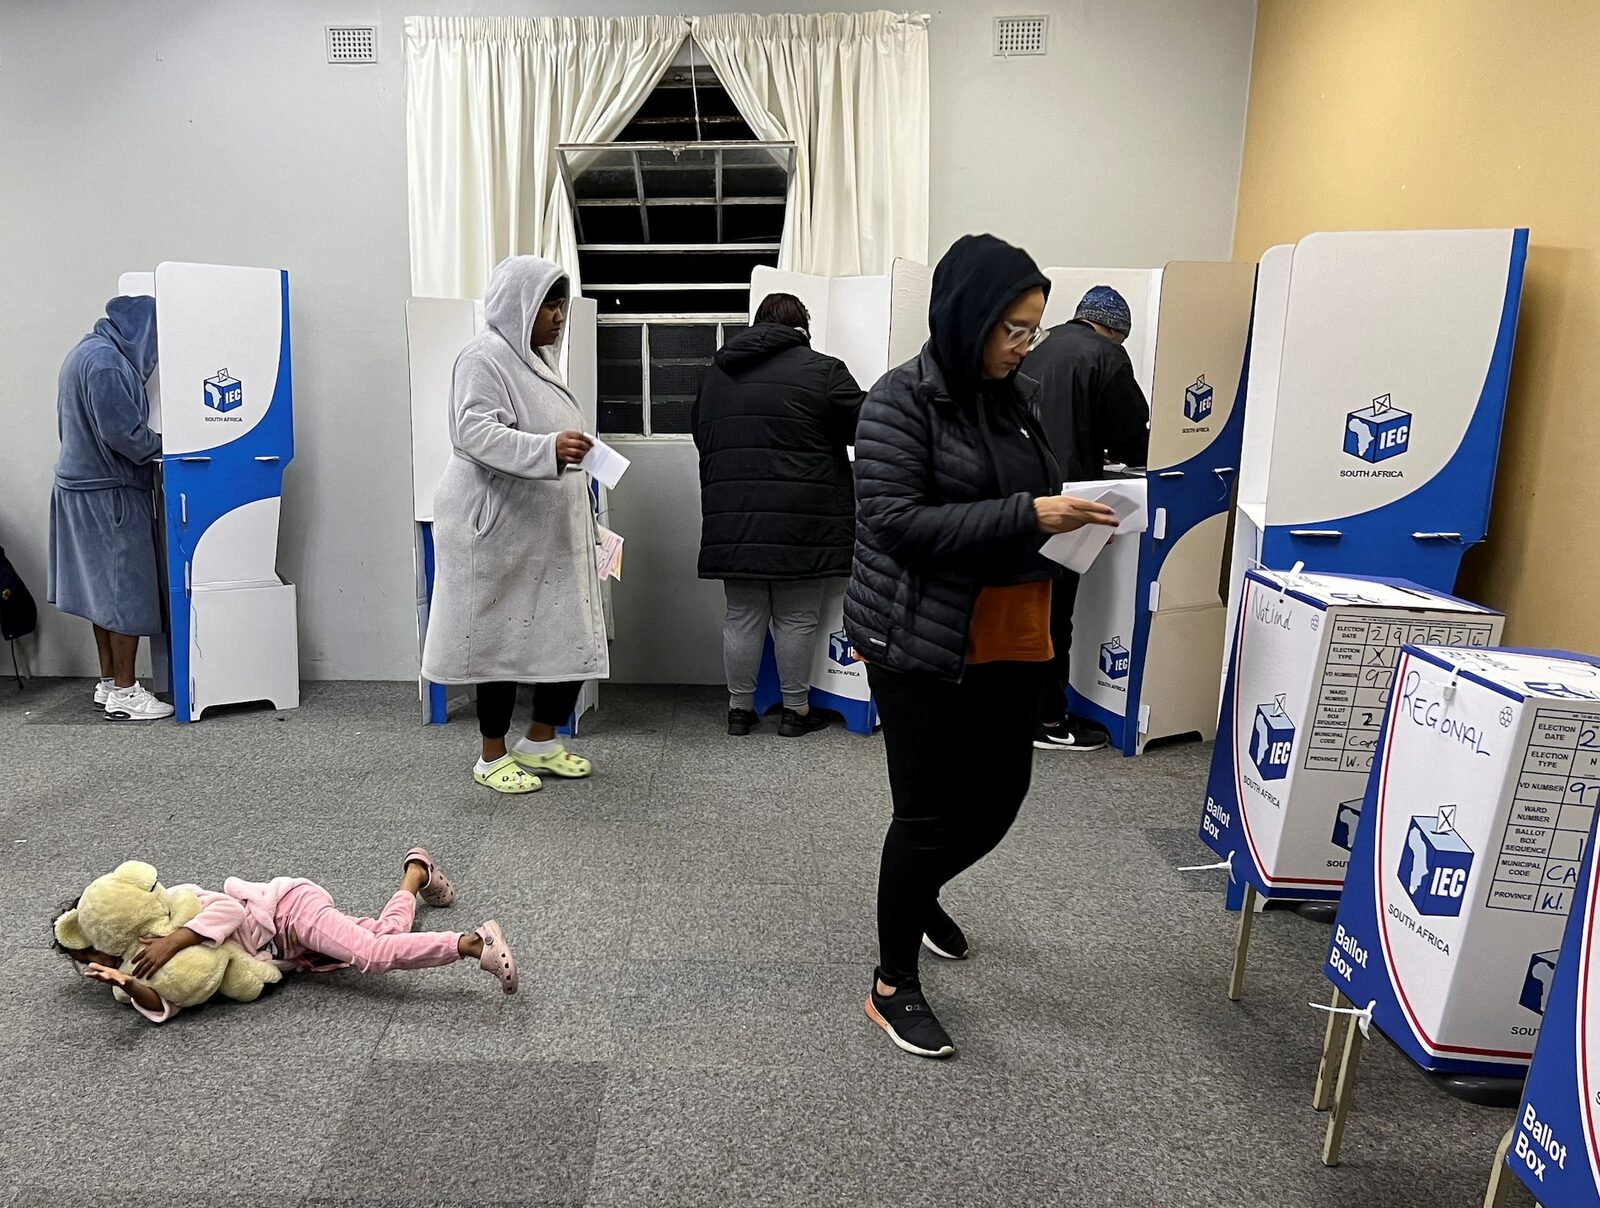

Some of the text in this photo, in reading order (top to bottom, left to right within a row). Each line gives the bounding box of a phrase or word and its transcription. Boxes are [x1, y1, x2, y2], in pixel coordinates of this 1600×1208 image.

[225, 388, 241, 404] IEC
[1199, 396, 1212, 413] IEC
[1379, 425, 1408, 450] IEC
[1371, 470, 1404, 478] AFRICA
[1115, 658, 1128, 671] IEC
[1538, 723, 1576, 732] ELECTION
[1545, 733, 1565, 741] DATE
[1269, 741, 1291, 765] IEC
[1531, 751, 1569, 760] ELECTION
[1538, 761, 1557, 769] TYPE
[1590, 758, 1597, 766] N
[1243, 775, 1281, 809] SOUTH AFRICA
[1531, 783, 1564, 792] NUMBER
[1207, 797, 1231, 828] Ballot
[1524, 805, 1547, 814] WARD
[1517, 814, 1550, 823] NUMBER
[1203, 814, 1220, 840] Box
[1515, 828, 1546, 837] BALLOT
[1505, 844, 1547, 854] SEQUENCE
[1326, 860, 1349, 868] SOU
[1501, 860, 1541, 869] MUNICIPAL
[1508, 869, 1531, 877] CODE
[1430, 867, 1466, 898] IEC
[1494, 891, 1533, 901] PROVINCE
[1388, 903, 1450, 956] SOUTH AFRICA
[1335, 924, 1368, 969] Ballot
[1330, 946, 1353, 982] Box
[1510, 1026, 1539, 1036] SOU
[1522, 1102, 1567, 1170] Ballot
[1515, 1130, 1547, 1183] Box
